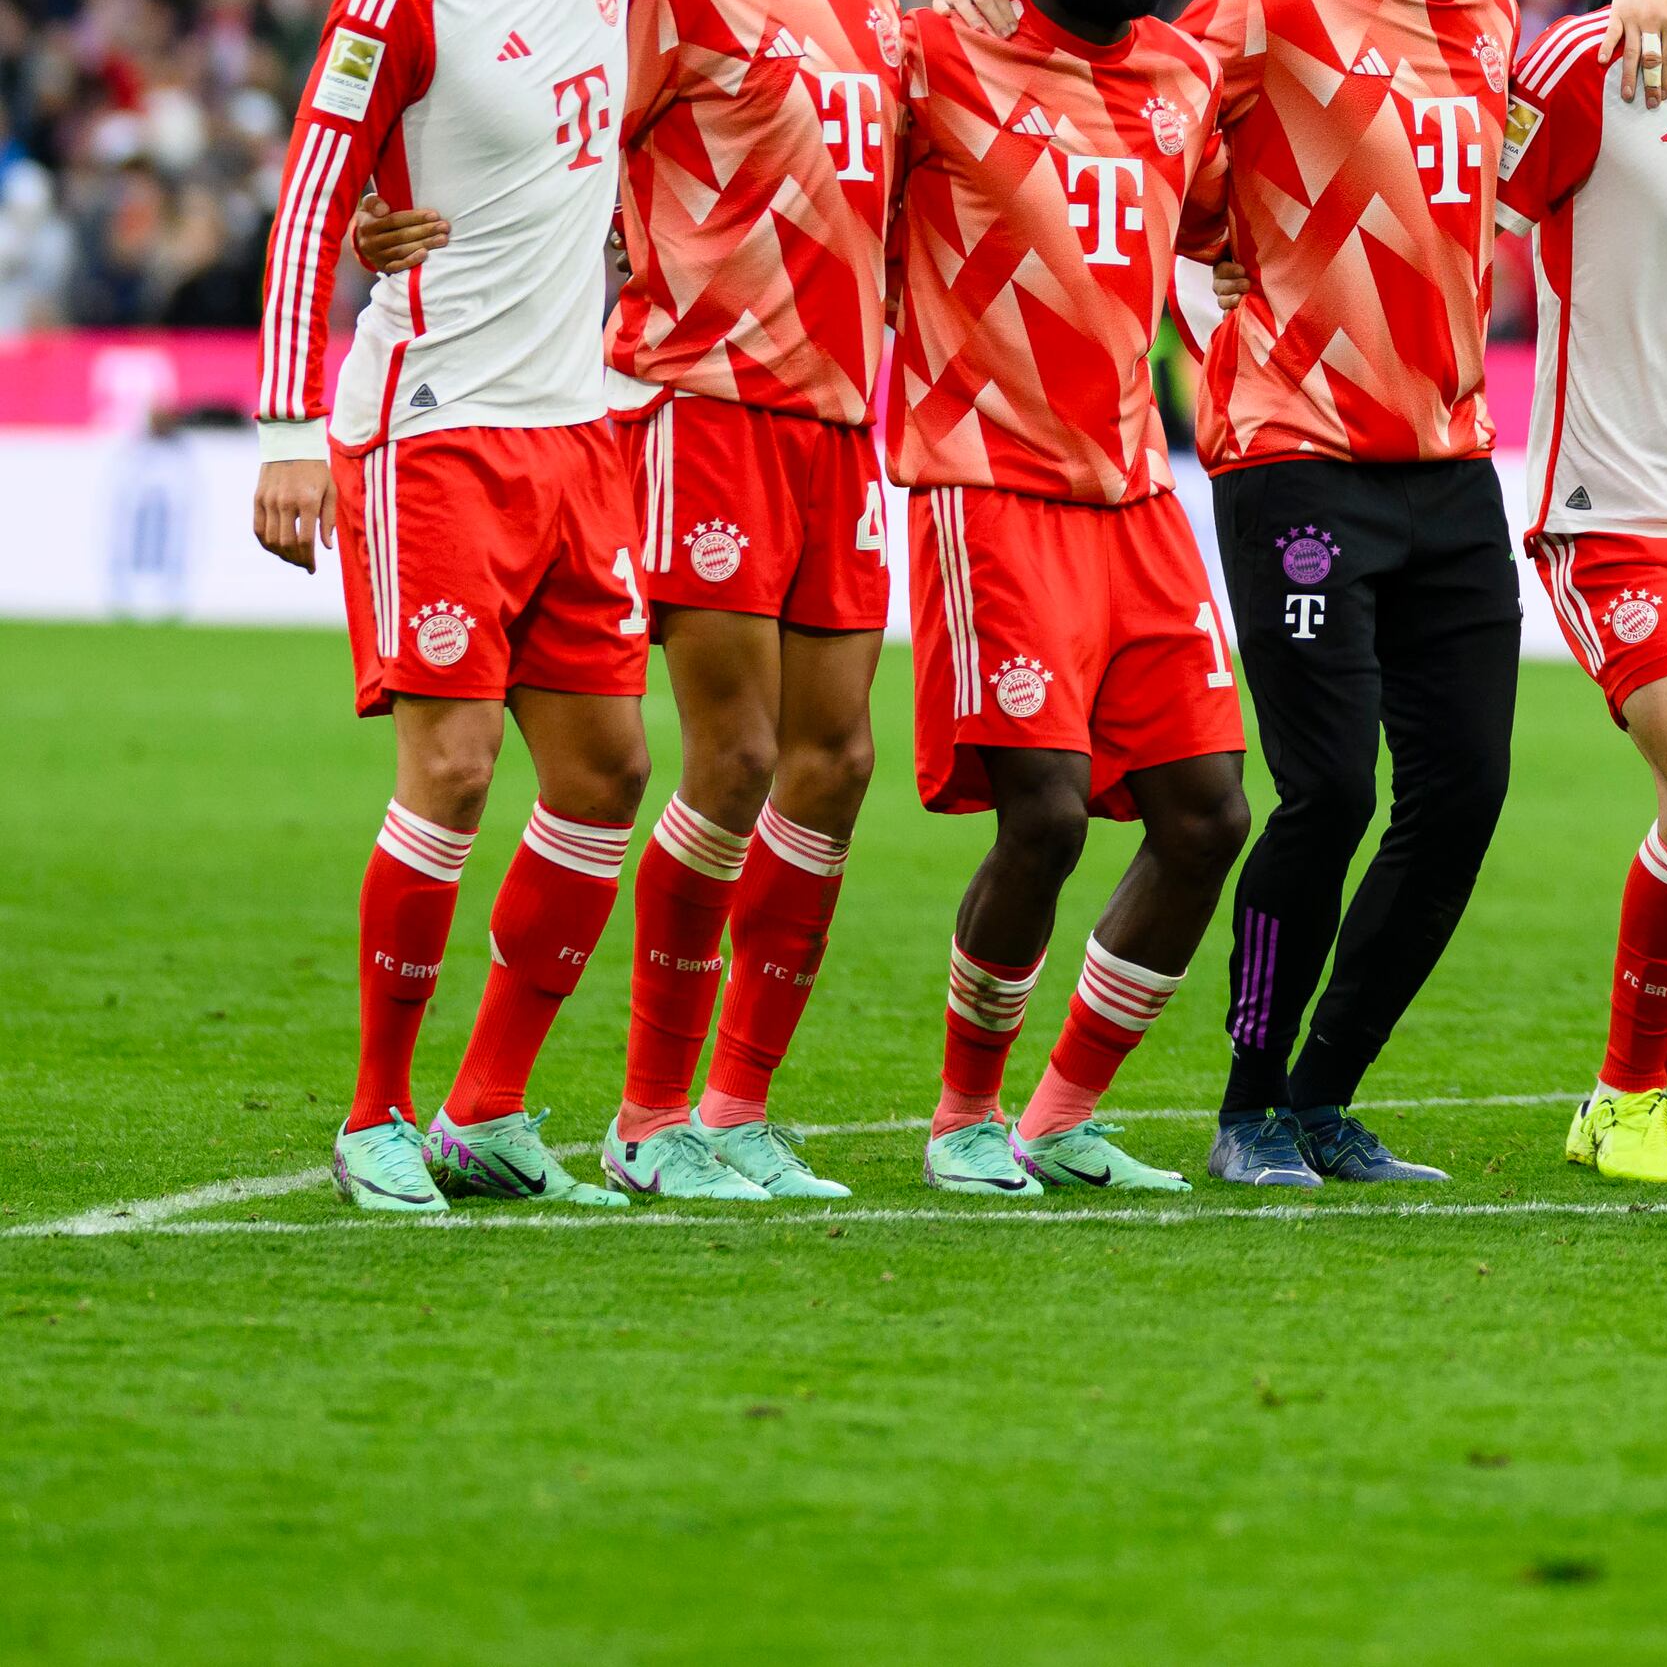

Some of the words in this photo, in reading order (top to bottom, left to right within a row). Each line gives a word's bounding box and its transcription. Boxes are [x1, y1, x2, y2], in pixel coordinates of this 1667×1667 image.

[375, 950, 394, 971] FC
[558, 946, 585, 964] FC
[650, 950, 669, 966] FC
[763, 962, 788, 979] FC
[1623, 970, 1639, 988] FC
